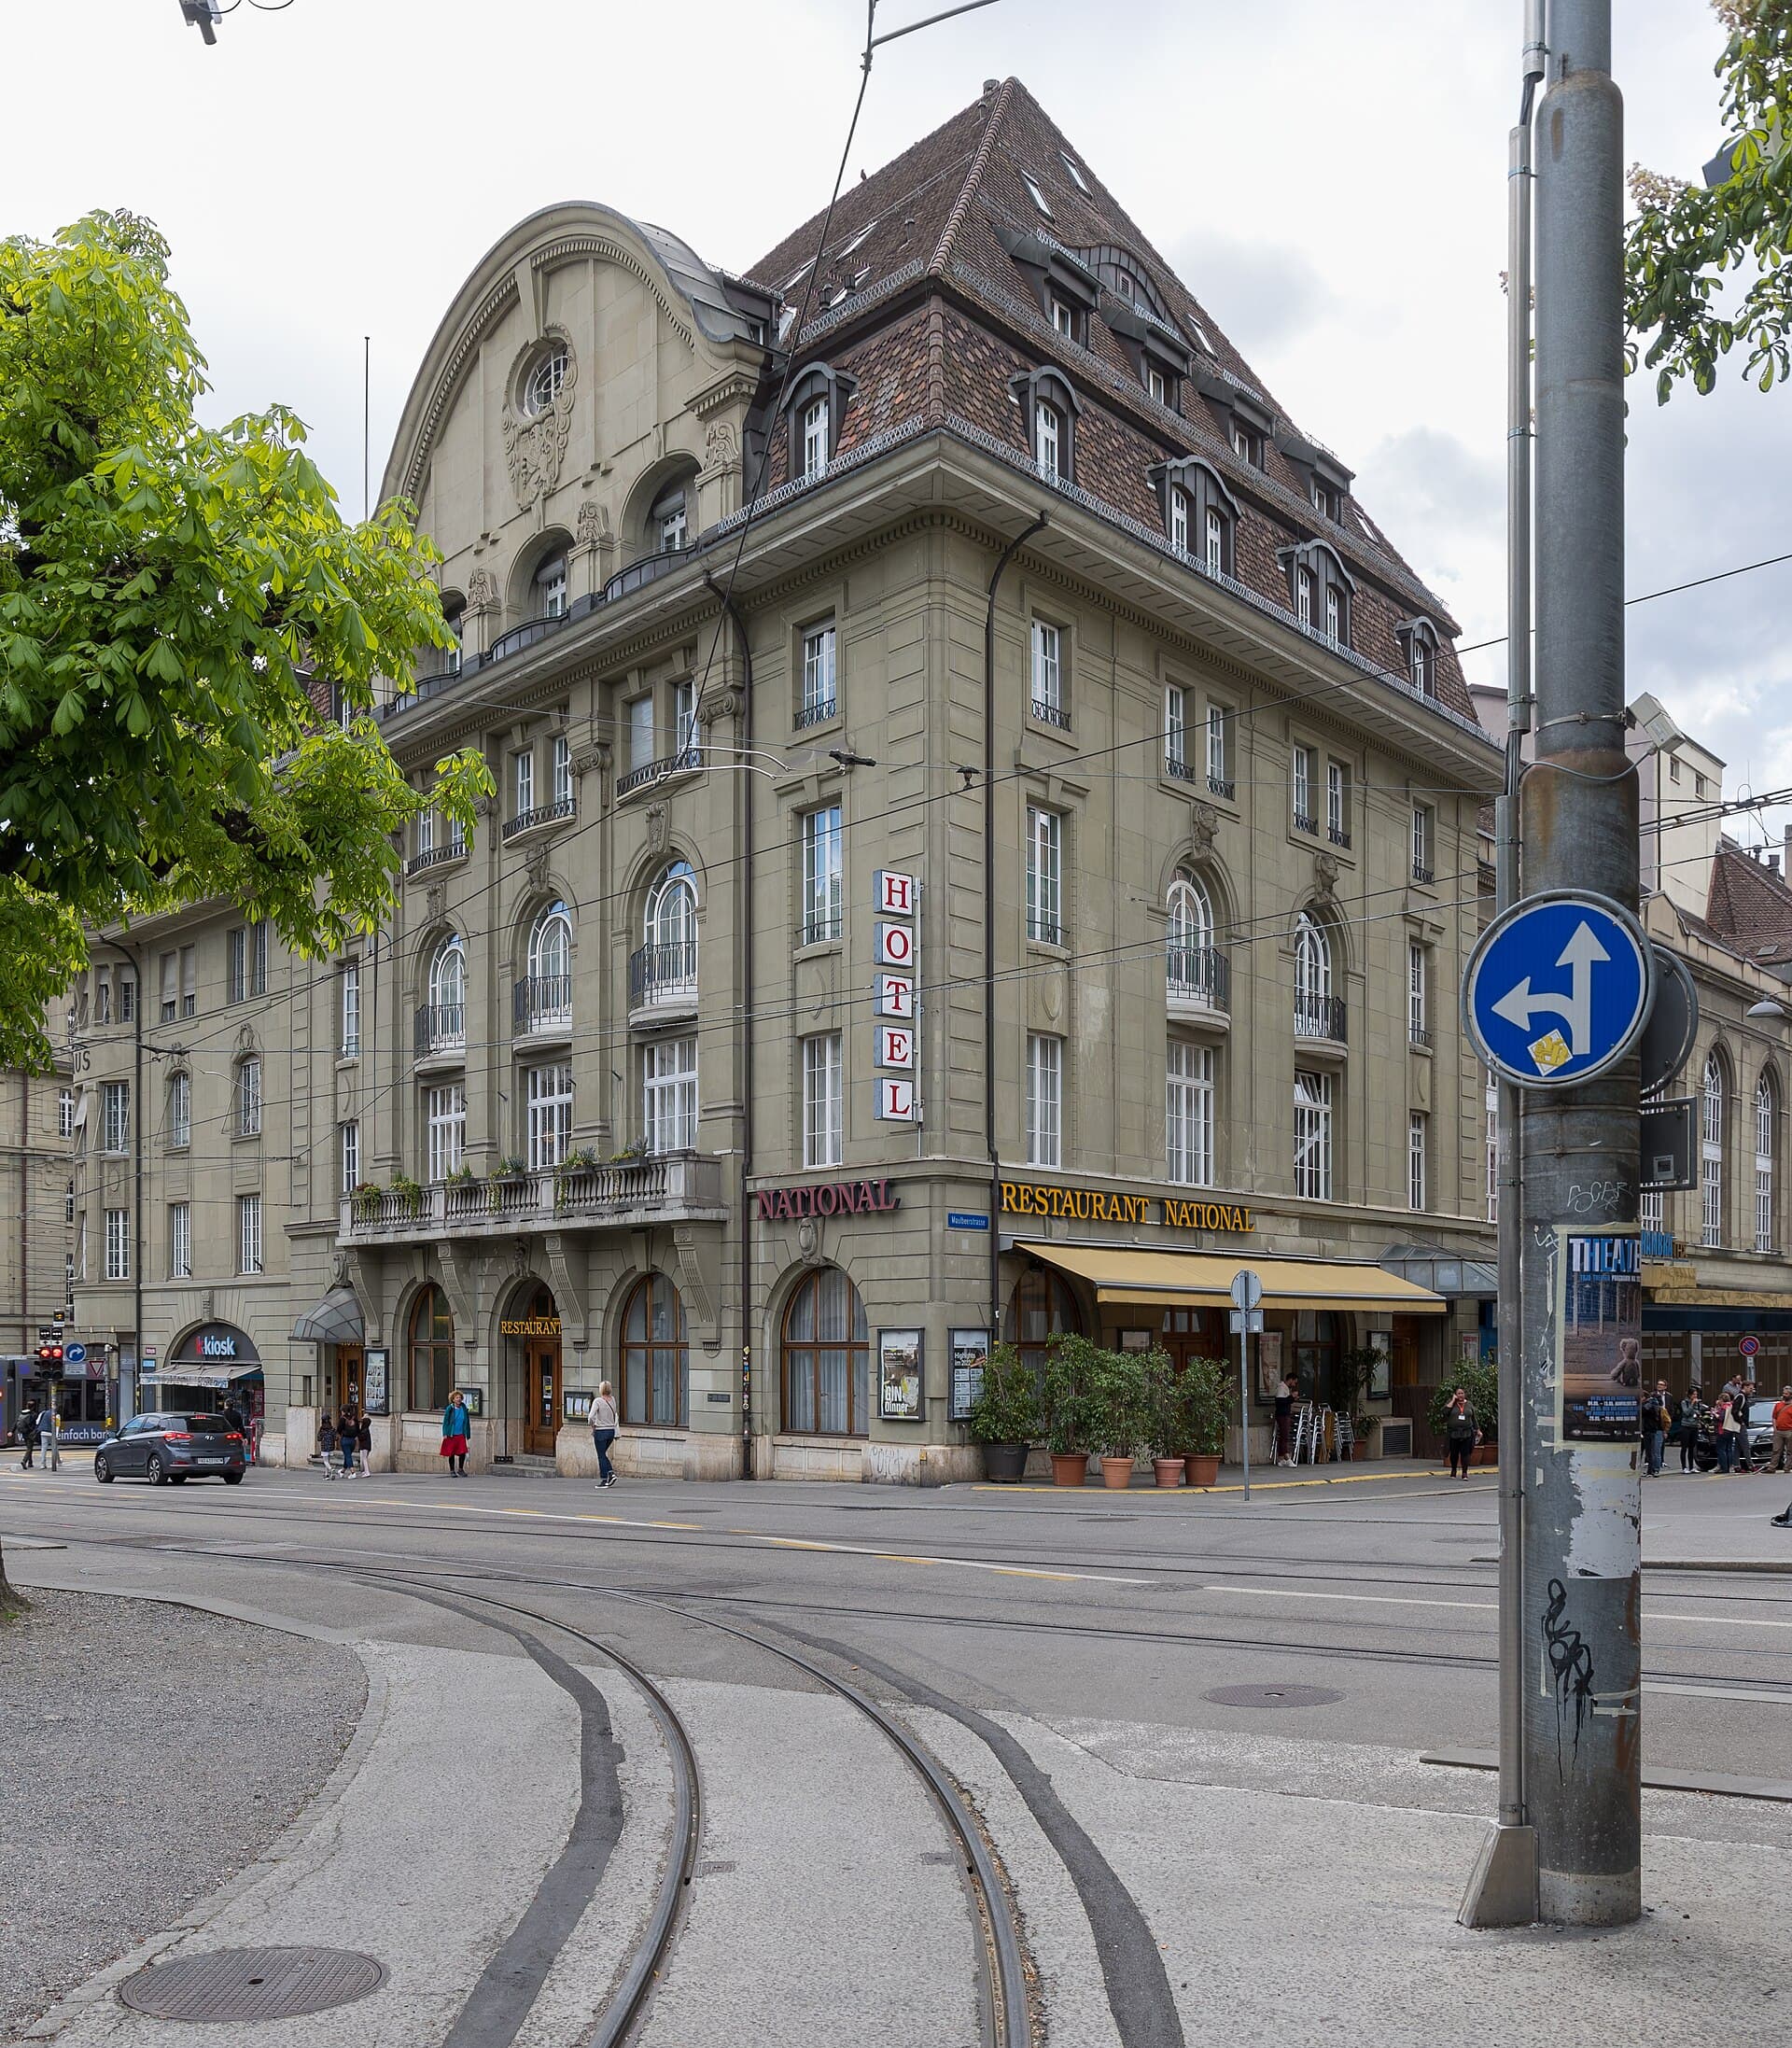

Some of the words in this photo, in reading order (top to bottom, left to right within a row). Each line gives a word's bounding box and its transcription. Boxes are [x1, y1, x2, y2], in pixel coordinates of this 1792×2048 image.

[885, 877, 911, 1115] HOTEL
[757, 1179, 899, 1220] NATIONAL
[1001, 1183, 1151, 1224] RESTAURANT
[1164, 1199, 1255, 1232] NATIONAL
[951, 1215, 986, 1227] Maulbeerstrasse
[500, 1320, 562, 1335] RESTAURANT
[885, 1401, 909, 1413] Dinner
[56, 1428, 89, 1440] einfach
